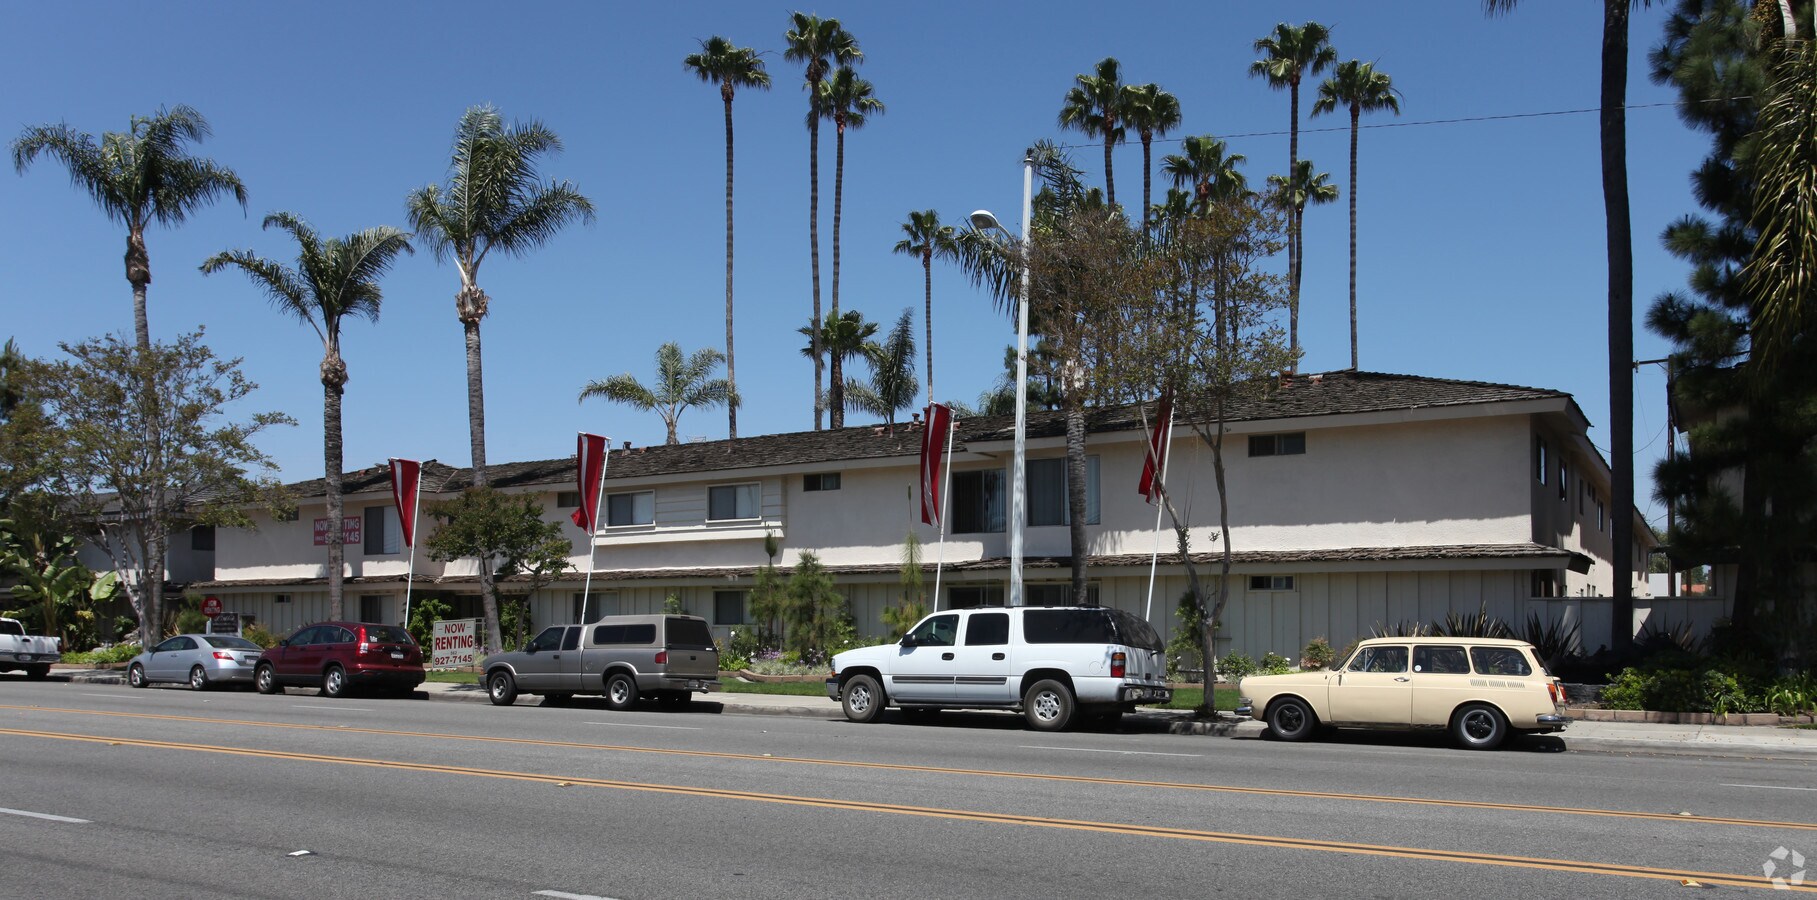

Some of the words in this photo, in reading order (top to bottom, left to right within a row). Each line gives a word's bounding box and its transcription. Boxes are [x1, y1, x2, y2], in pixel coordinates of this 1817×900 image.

[444, 623, 466, 634] NOW
[435, 635, 473, 651] RENTING
[434, 654, 473, 666] 927-7145
